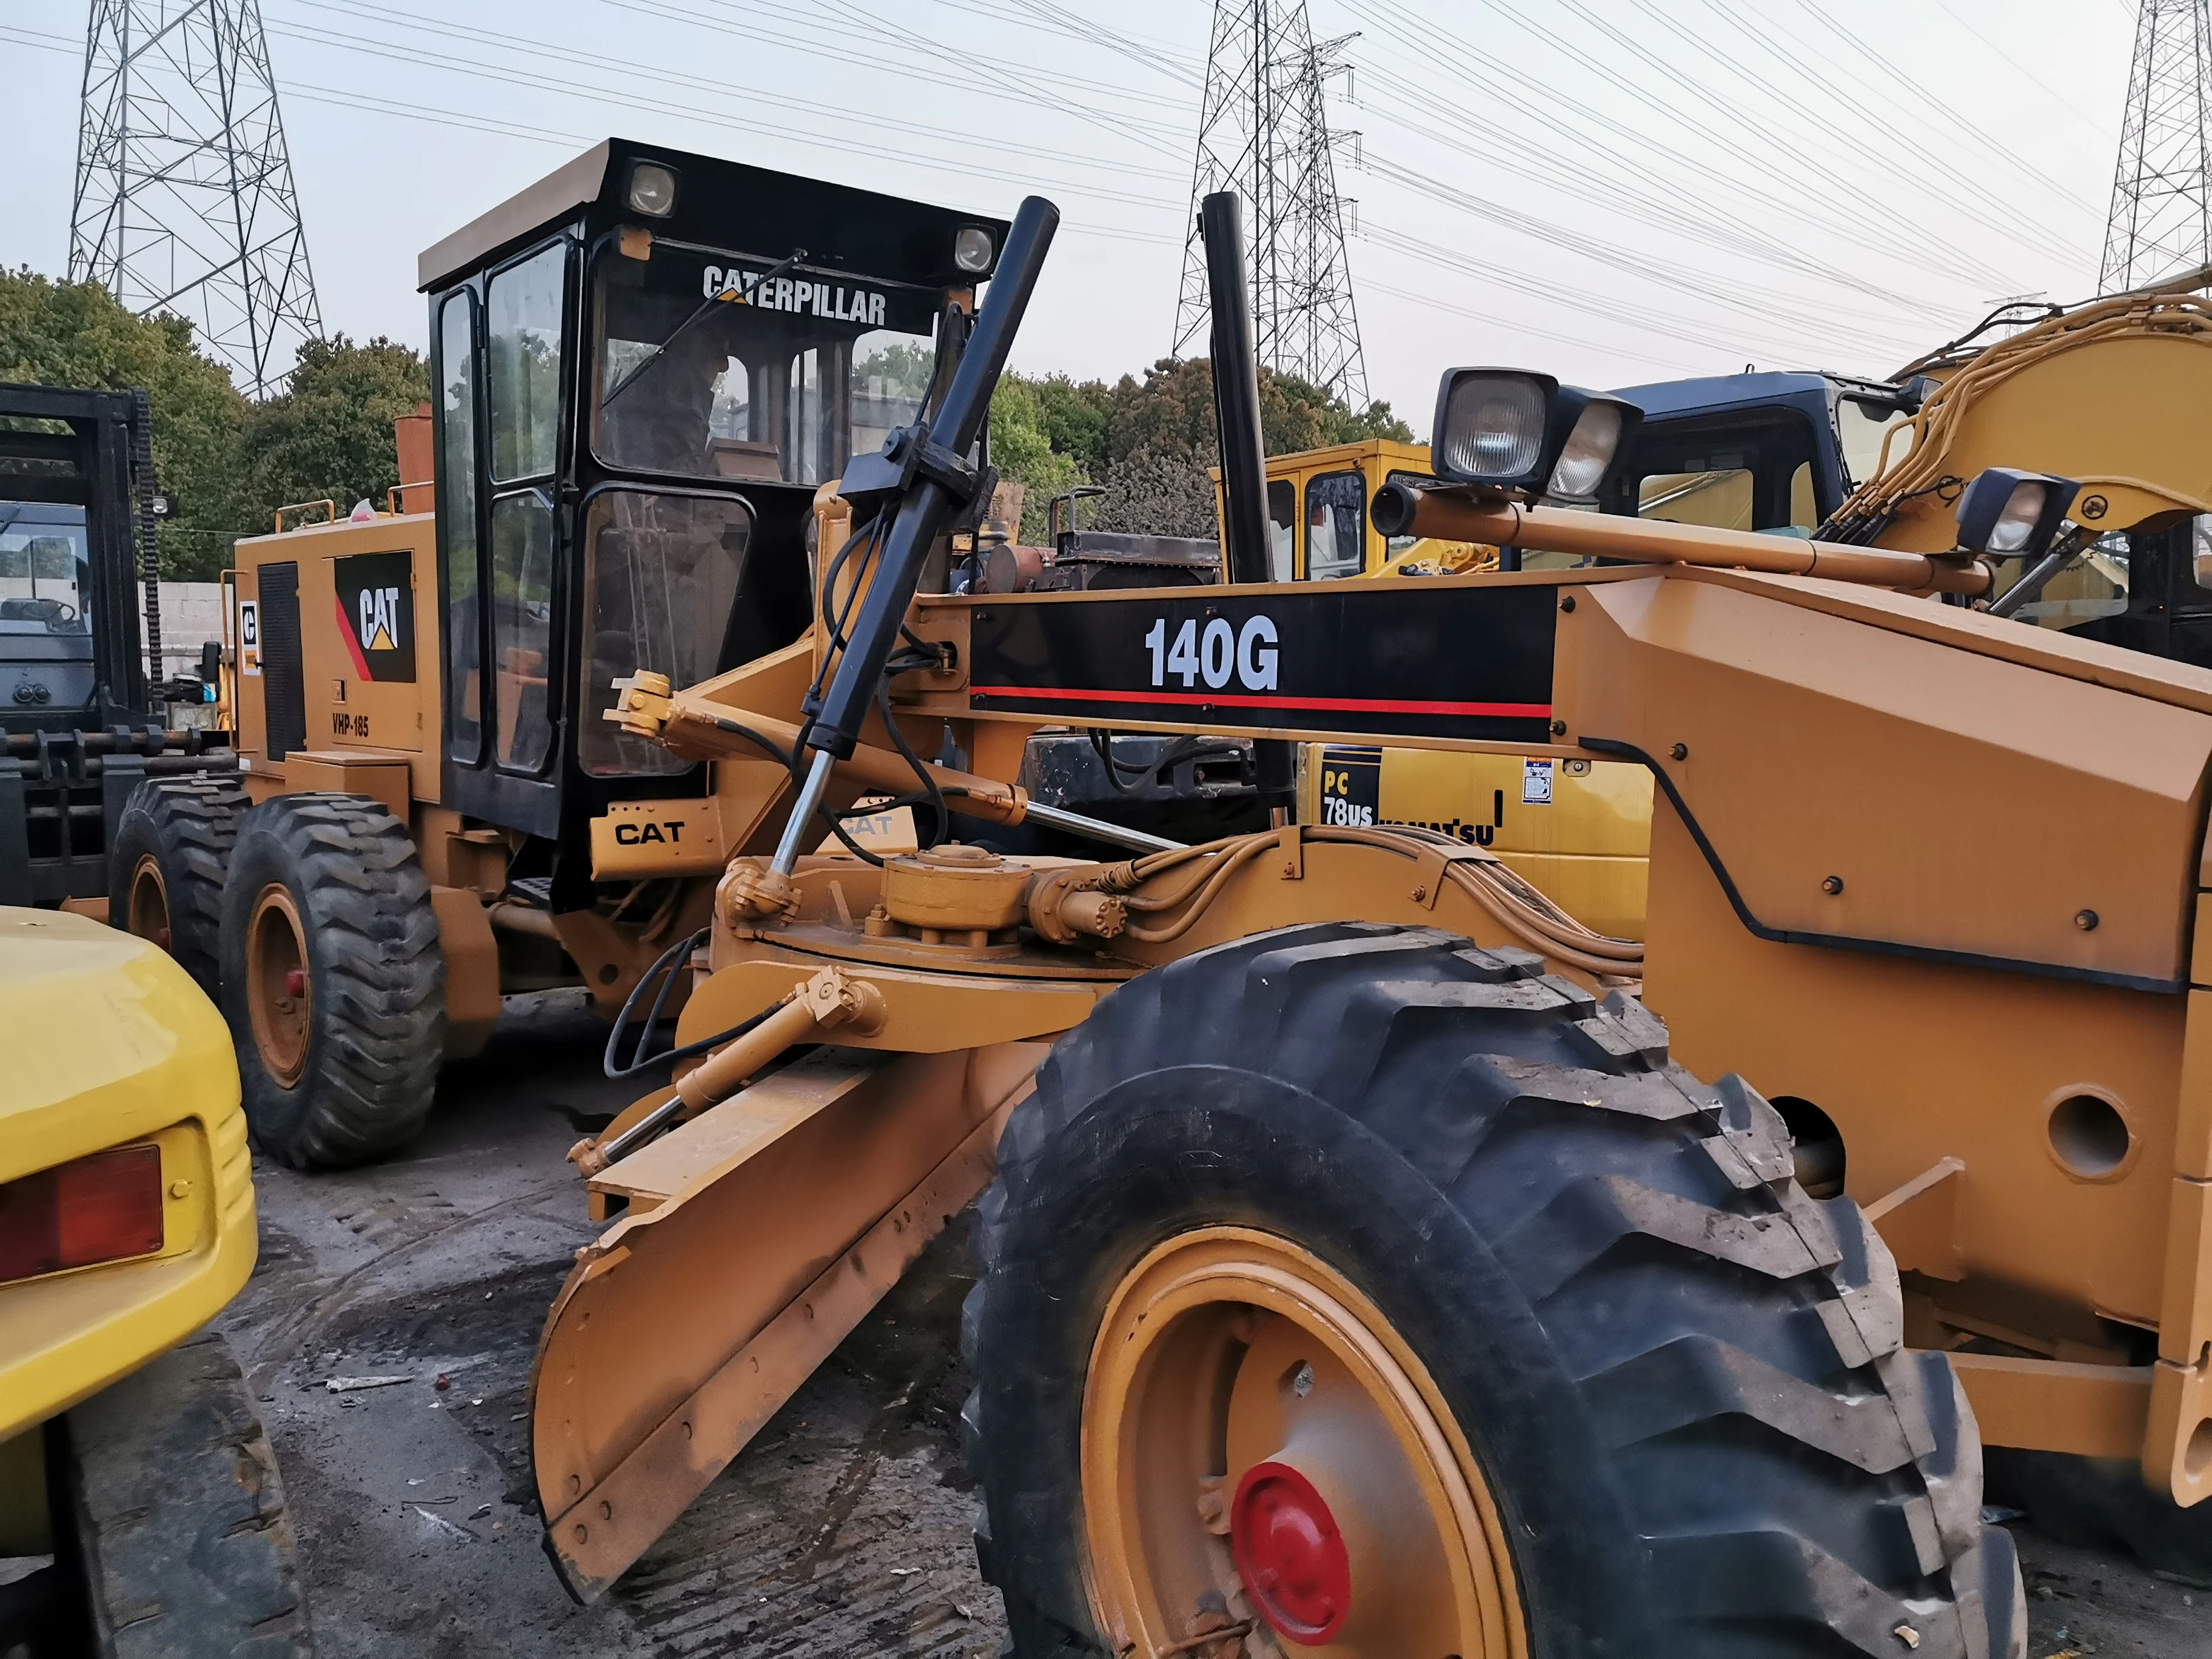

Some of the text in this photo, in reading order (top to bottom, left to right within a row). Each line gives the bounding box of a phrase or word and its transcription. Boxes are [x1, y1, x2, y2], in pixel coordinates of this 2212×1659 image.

[703, 265, 886, 326] CATERPILLAR
[359, 587, 399, 649] CAT
[1145, 615, 1278, 691] 140G
[332, 712, 369, 738] VHP-185
[1324, 771, 1349, 795] PC
[615, 821, 685, 845] CAT
